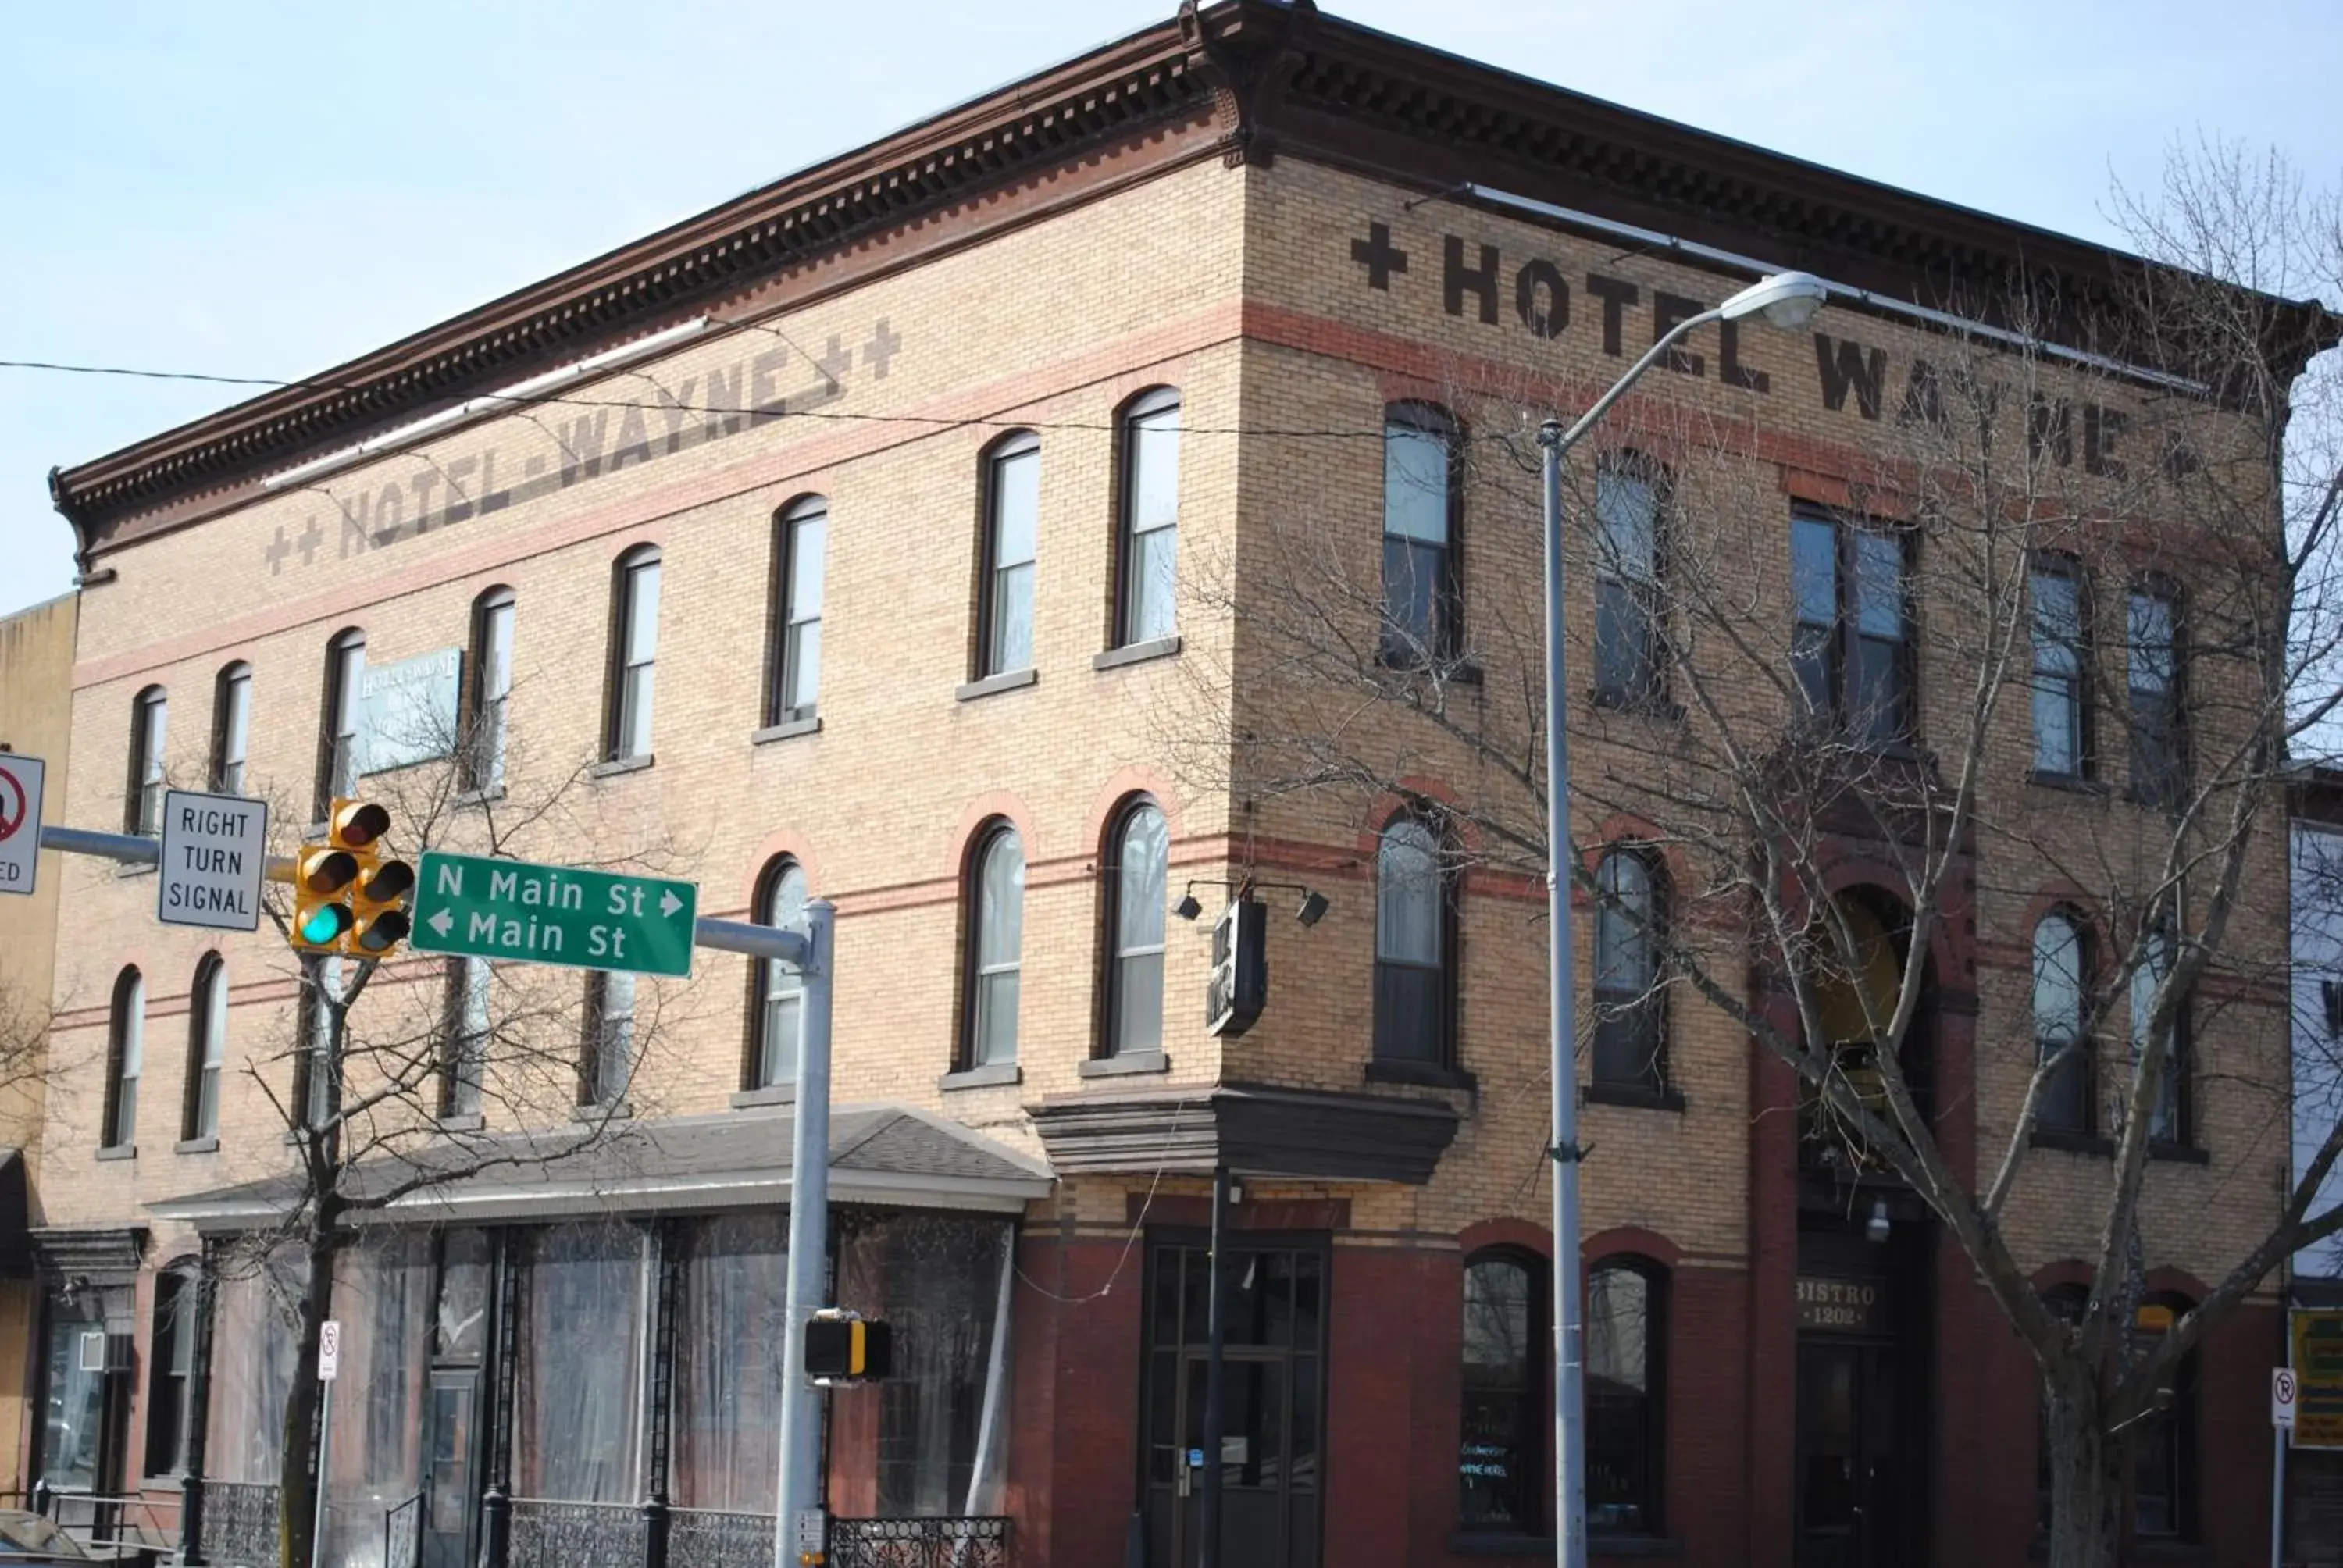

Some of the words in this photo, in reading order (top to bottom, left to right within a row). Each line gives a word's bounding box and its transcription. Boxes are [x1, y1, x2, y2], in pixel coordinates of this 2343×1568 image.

[1443, 234, 1770, 393] HOTEL
[339, 448, 510, 560] HOTEL
[558, 344, 787, 489] WAYNE
[182, 807, 248, 838] RIGHT
[184, 846, 242, 875] TURN
[169, 882, 249, 914] SIGNAL
[437, 864, 463, 896] N
[490, 870, 583, 911] Main
[607, 883, 645, 918] St
[468, 911, 564, 953] Main
[587, 925, 626, 959] St
